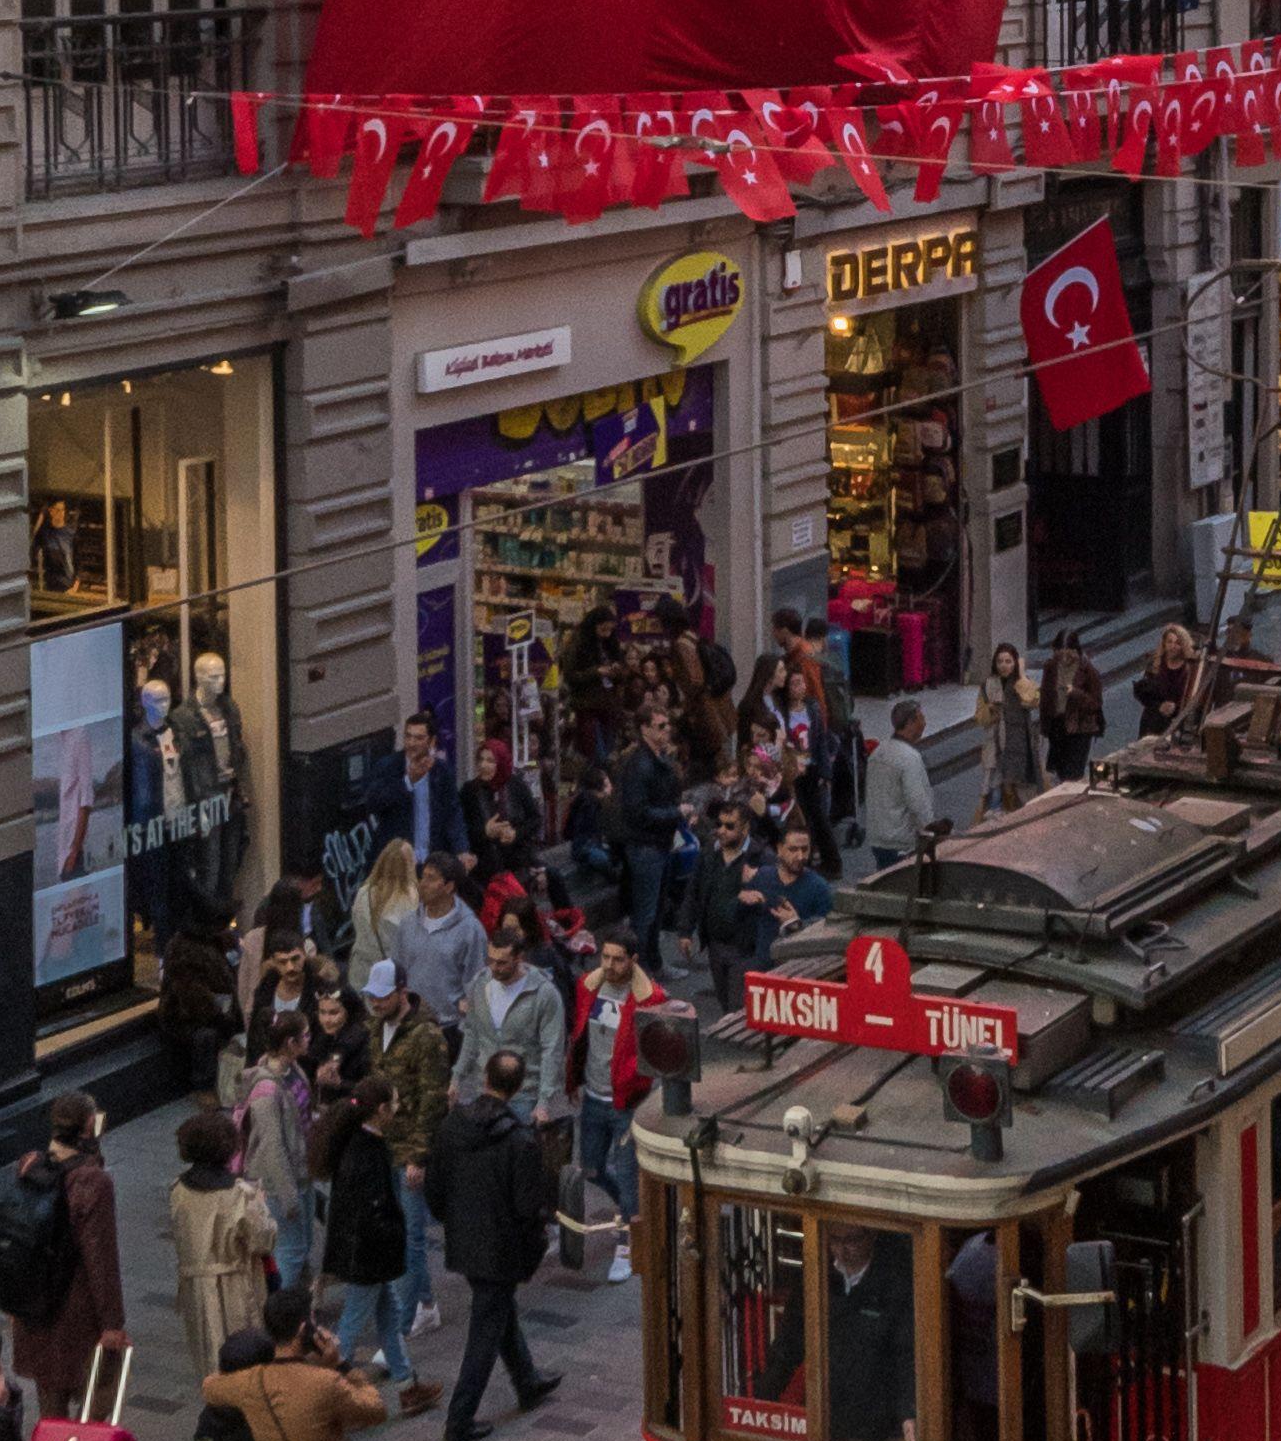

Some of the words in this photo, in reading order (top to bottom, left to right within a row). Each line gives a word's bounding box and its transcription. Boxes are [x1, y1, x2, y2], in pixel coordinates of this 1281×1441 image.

[828, 228, 978, 303] DERPA
[662, 262, 740, 331] gratis
[146, 814, 166, 850] AT
[169, 802, 197, 840] THE
[864, 941, 884, 984] 4
[748, 985, 838, 1032] TAKSİM
[925, 1004, 1013, 1056] TÜNEL
[729, 1405, 808, 1435] TAKSİM
